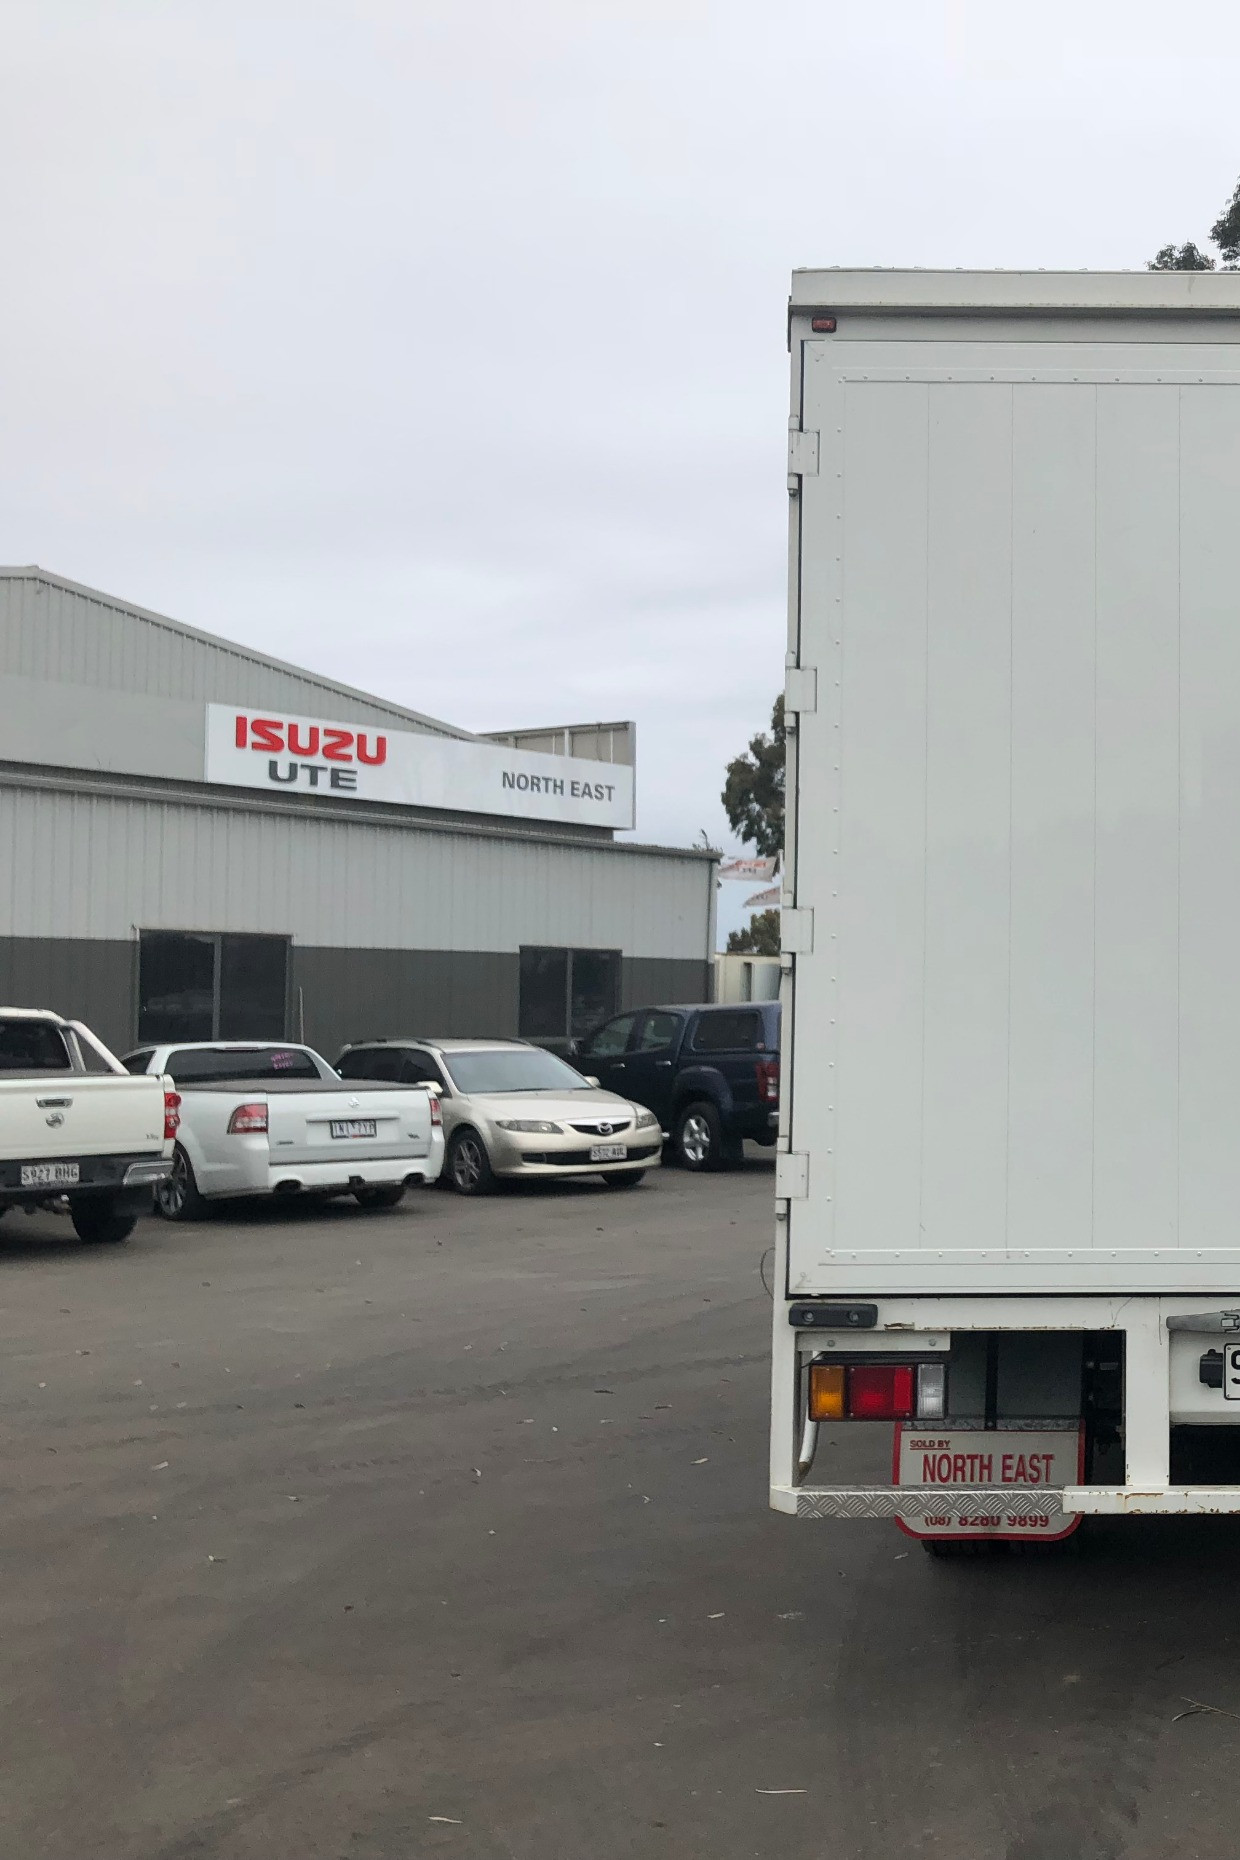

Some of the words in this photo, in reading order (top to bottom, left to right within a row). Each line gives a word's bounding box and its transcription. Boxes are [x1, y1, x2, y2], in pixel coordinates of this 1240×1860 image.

[235, 715, 388, 767] ISUZU
[267, 759, 359, 791] UTE
[502, 771, 565, 797] NORTH
[570, 781, 616, 803] EAST
[909, 1440, 936, 1448] SOLD
[938, 1440, 951, 1448] BY
[922, 1454, 993, 1483] NORTH
[1001, 1454, 1055, 1483] EAST
